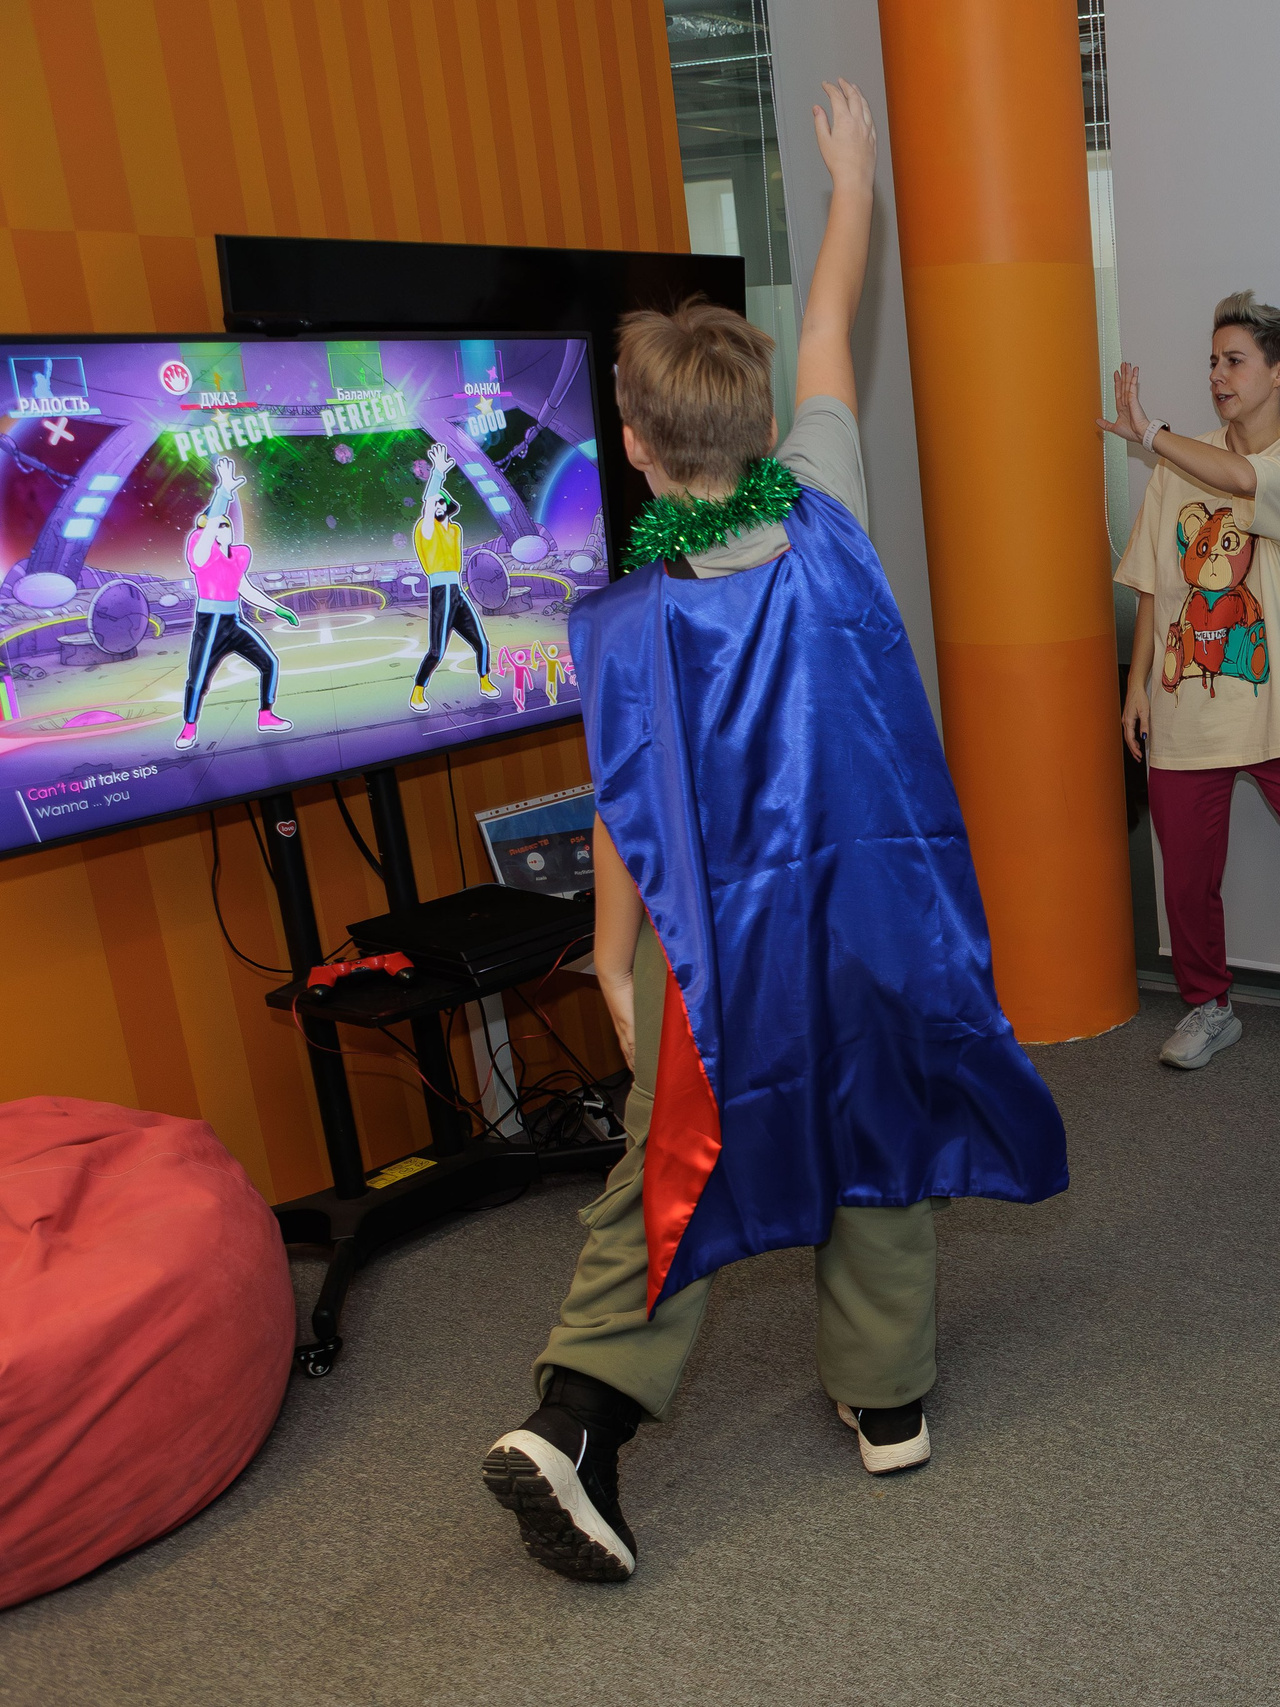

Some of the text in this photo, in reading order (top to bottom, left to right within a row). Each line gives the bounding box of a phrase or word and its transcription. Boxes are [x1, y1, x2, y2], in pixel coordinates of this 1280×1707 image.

[200, 391, 238, 409] ДЖАЗ
[336, 388, 382, 401] Баламут
[464, 382, 501, 396] ФАНКИ
[19, 397, 90, 415] РАДОСТЬ
[321, 391, 407, 438] PERFECT
[174, 411, 274, 462] PERFECT
[468, 409, 507, 437] GOOD
[27, 765, 158, 801] Can't quit take sips
[35, 800, 89, 819] Wanna
[104, 790, 131, 806] you
